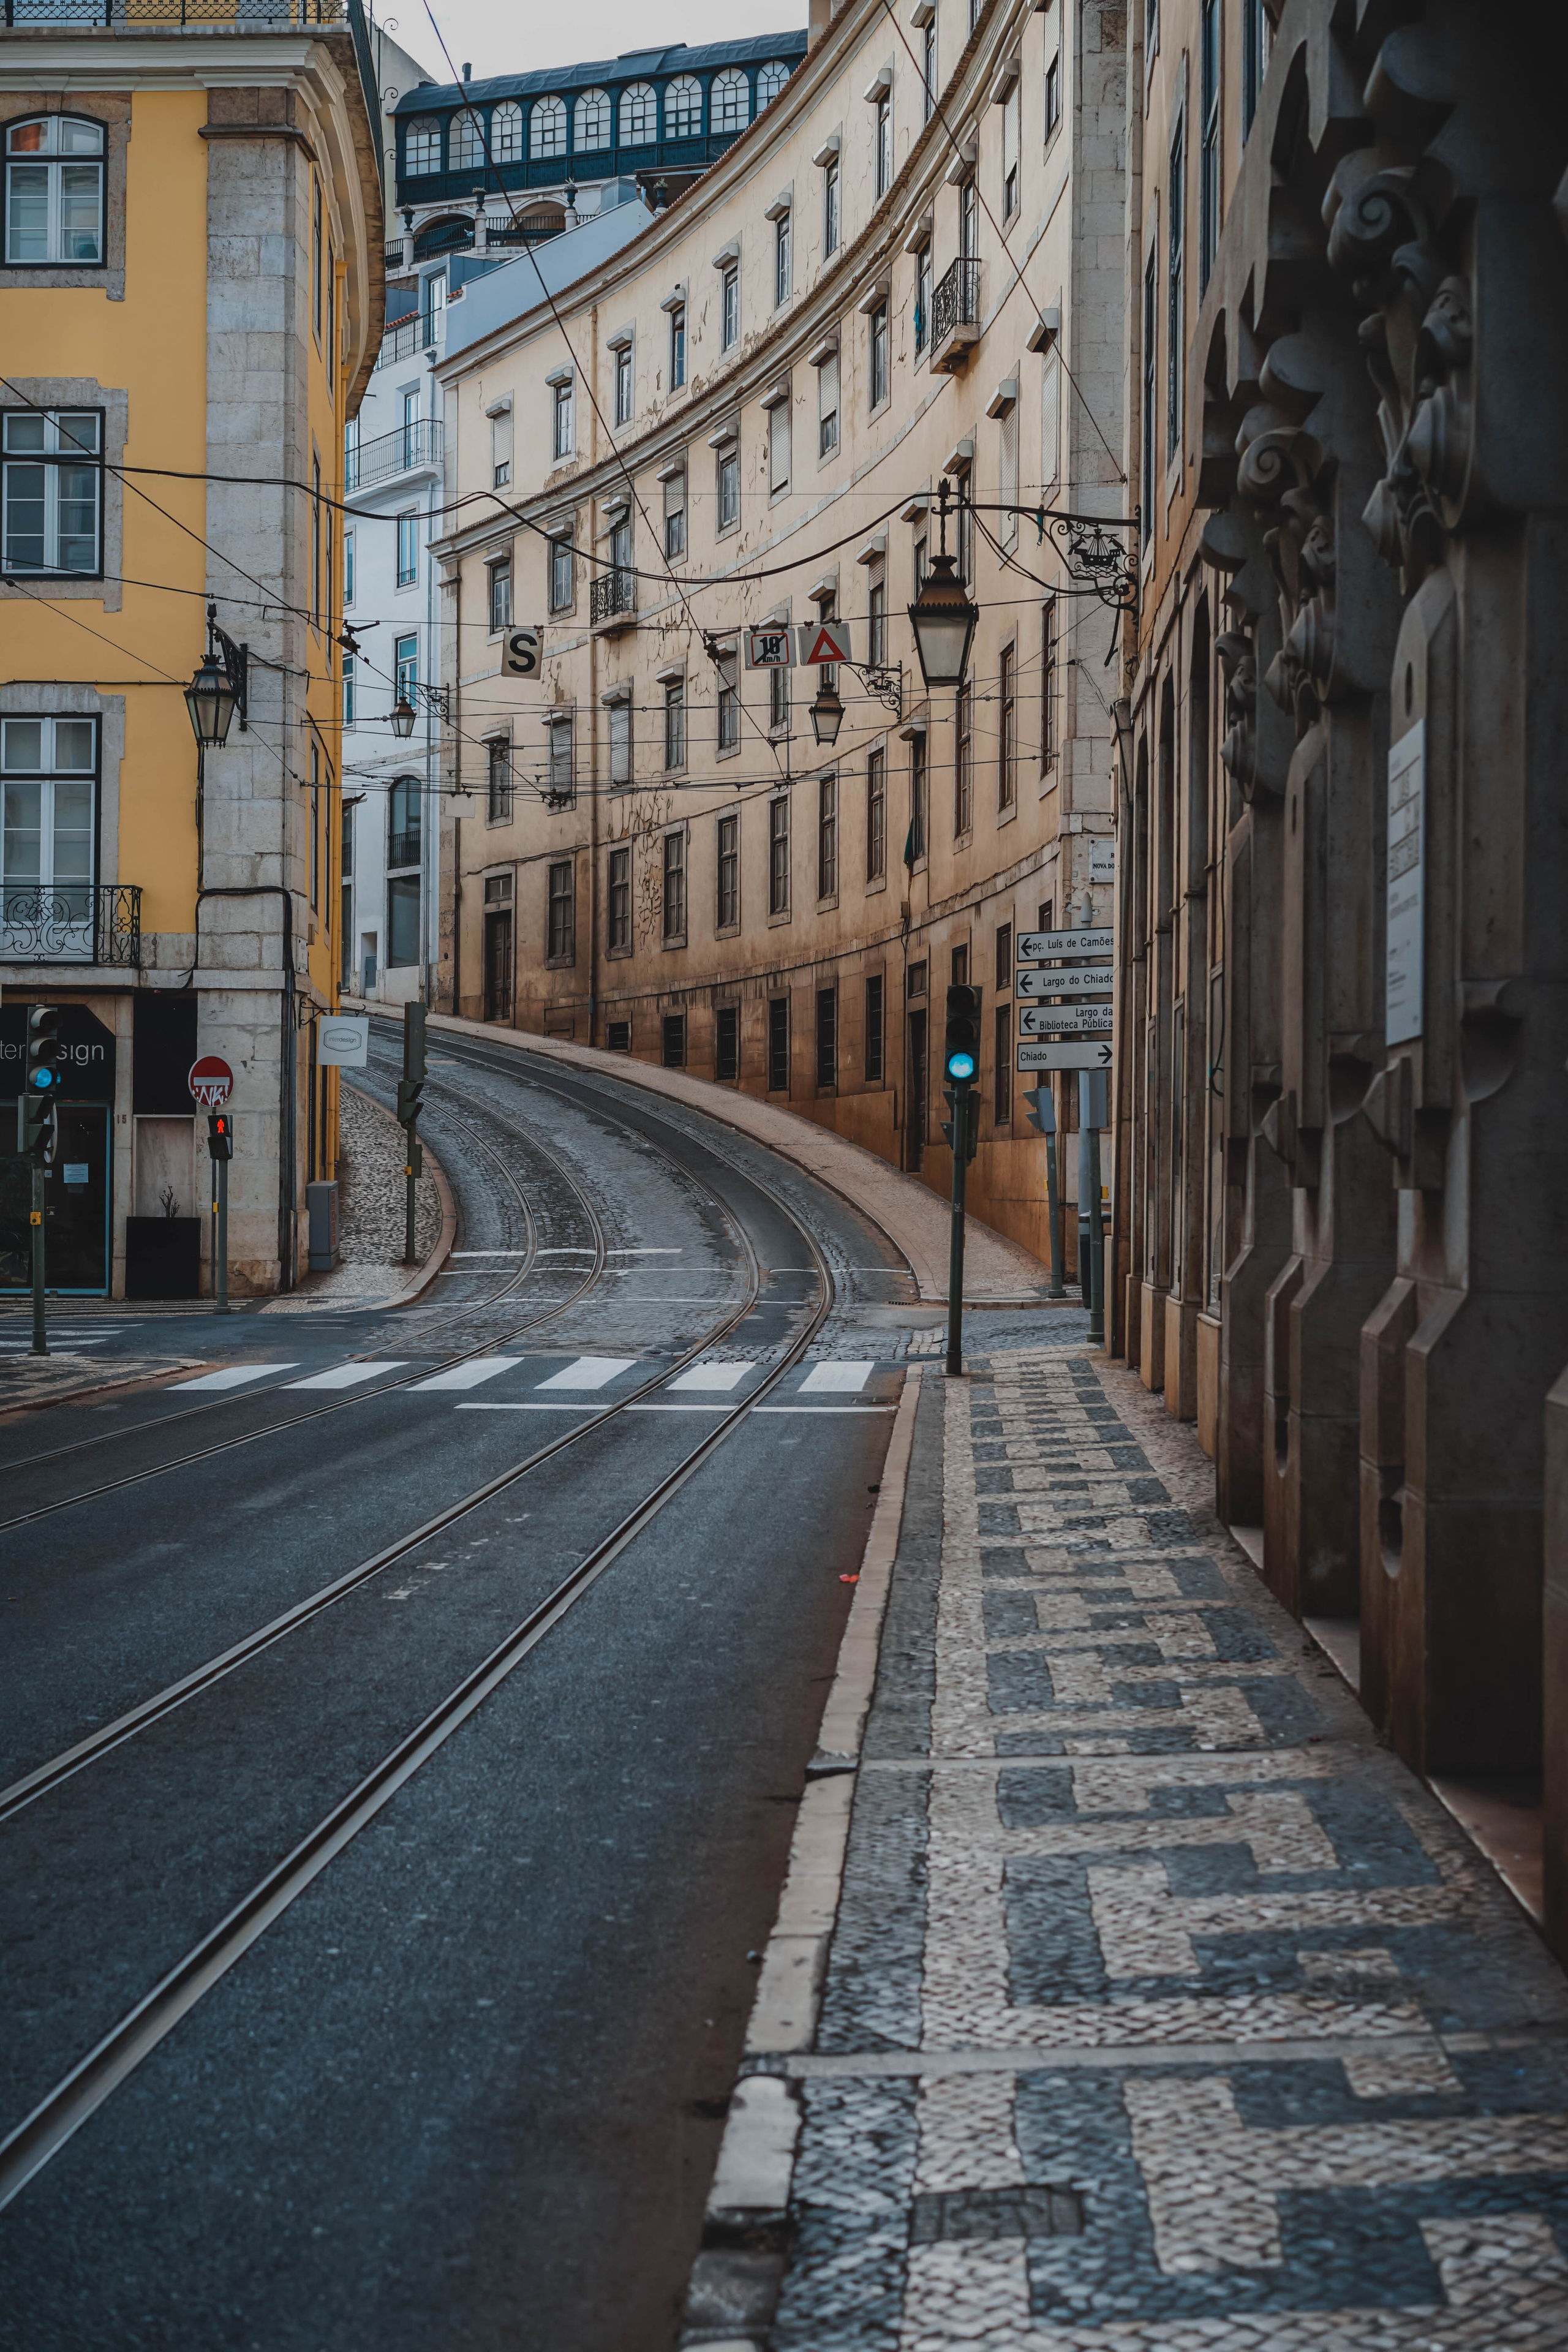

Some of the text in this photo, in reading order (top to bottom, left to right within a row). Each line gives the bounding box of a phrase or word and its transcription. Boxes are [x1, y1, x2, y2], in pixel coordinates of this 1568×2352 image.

[760, 636, 780, 655] 10
[508, 633, 538, 673] S
[1048, 939, 1063, 949] Luís
[1067, 938, 1076, 948] de
[1080, 937, 1114, 947] Camões
[1043, 978, 1065, 987] Largo
[1069, 975, 1079, 984] do
[1076, 1006, 1113, 1018] Largo da
[1039, 1019, 1113, 1030] Biblioteca Pública
[1020, 1051, 1047, 1061] Chiado
[117, 1114, 127, 1124] 15
